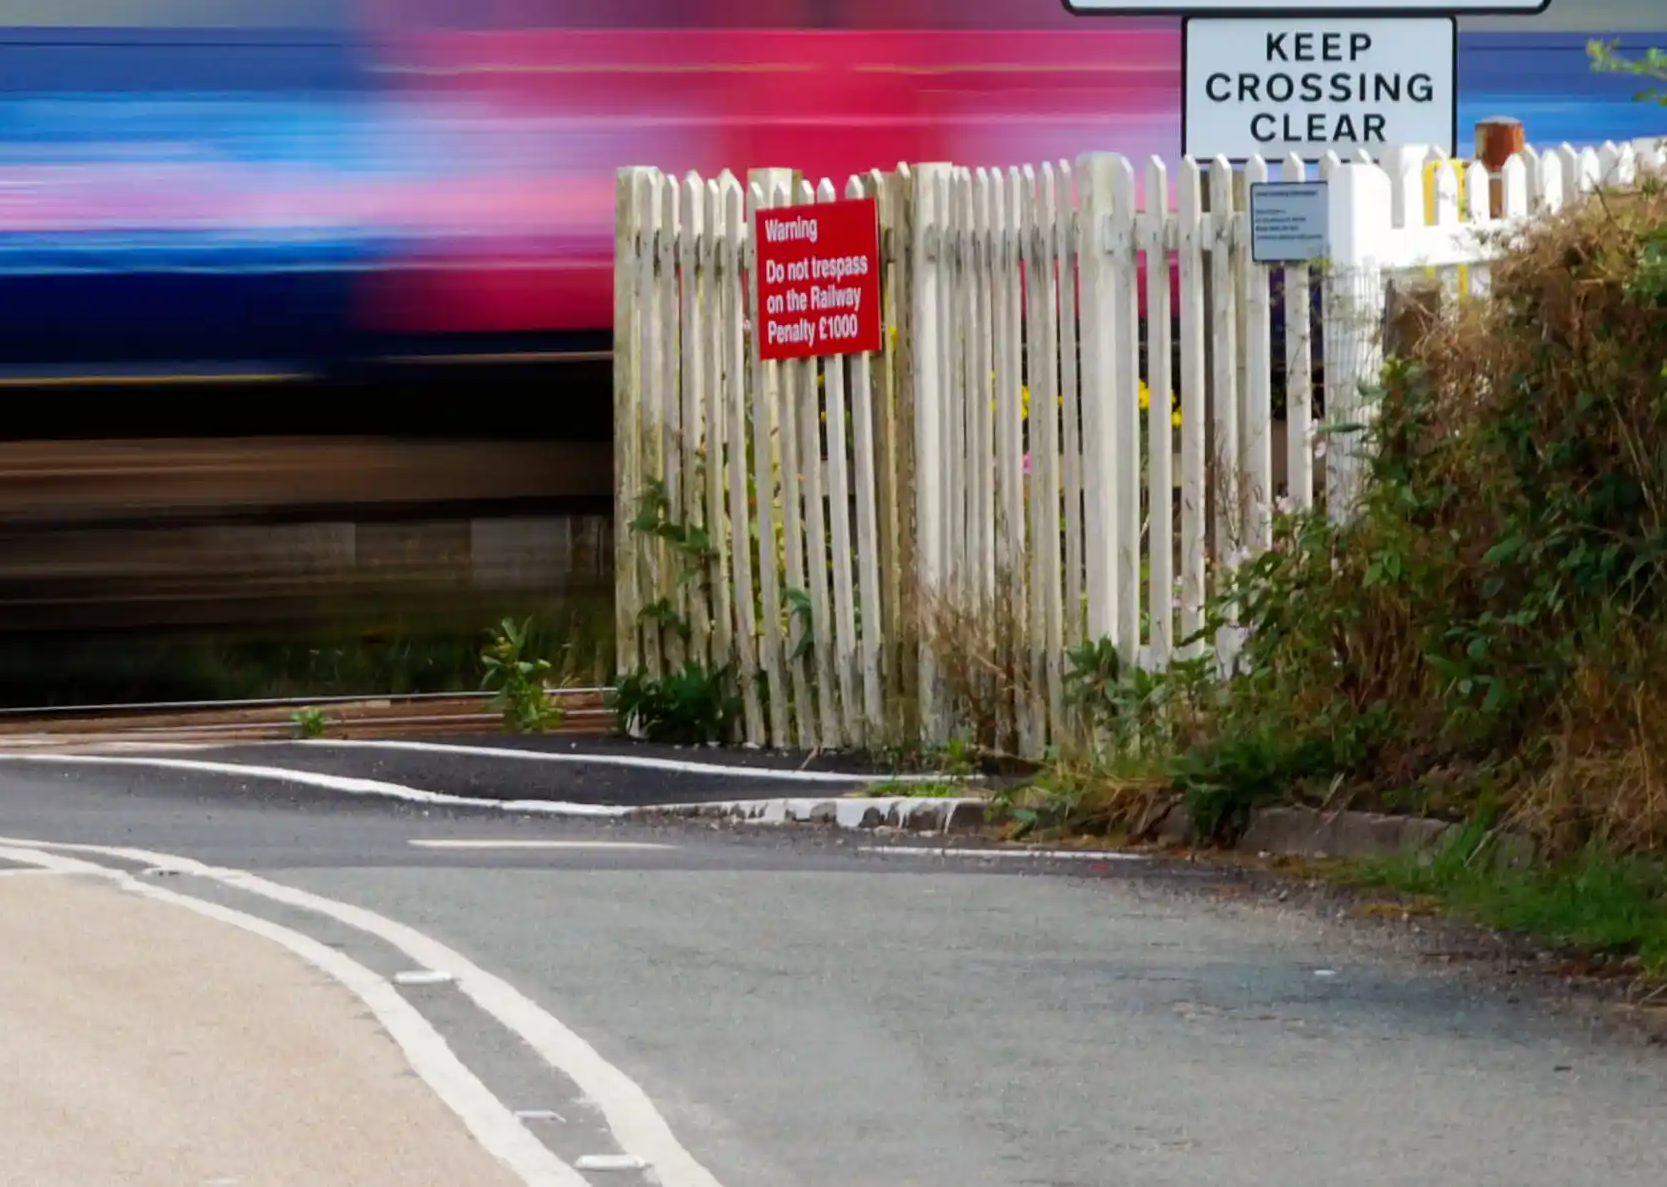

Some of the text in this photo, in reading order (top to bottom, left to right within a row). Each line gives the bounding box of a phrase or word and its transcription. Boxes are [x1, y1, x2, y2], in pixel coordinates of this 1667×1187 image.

[1265, 32, 1372, 62] KEEP
[1205, 71, 1434, 103] CROSSING
[1249, 112, 1387, 143] CLEAR
[765, 215, 818, 242] Warning
[766, 254, 868, 284] Do not trespass
[767, 284, 862, 314] on the Railway
[768, 314, 858, 347] Penalty £1000
